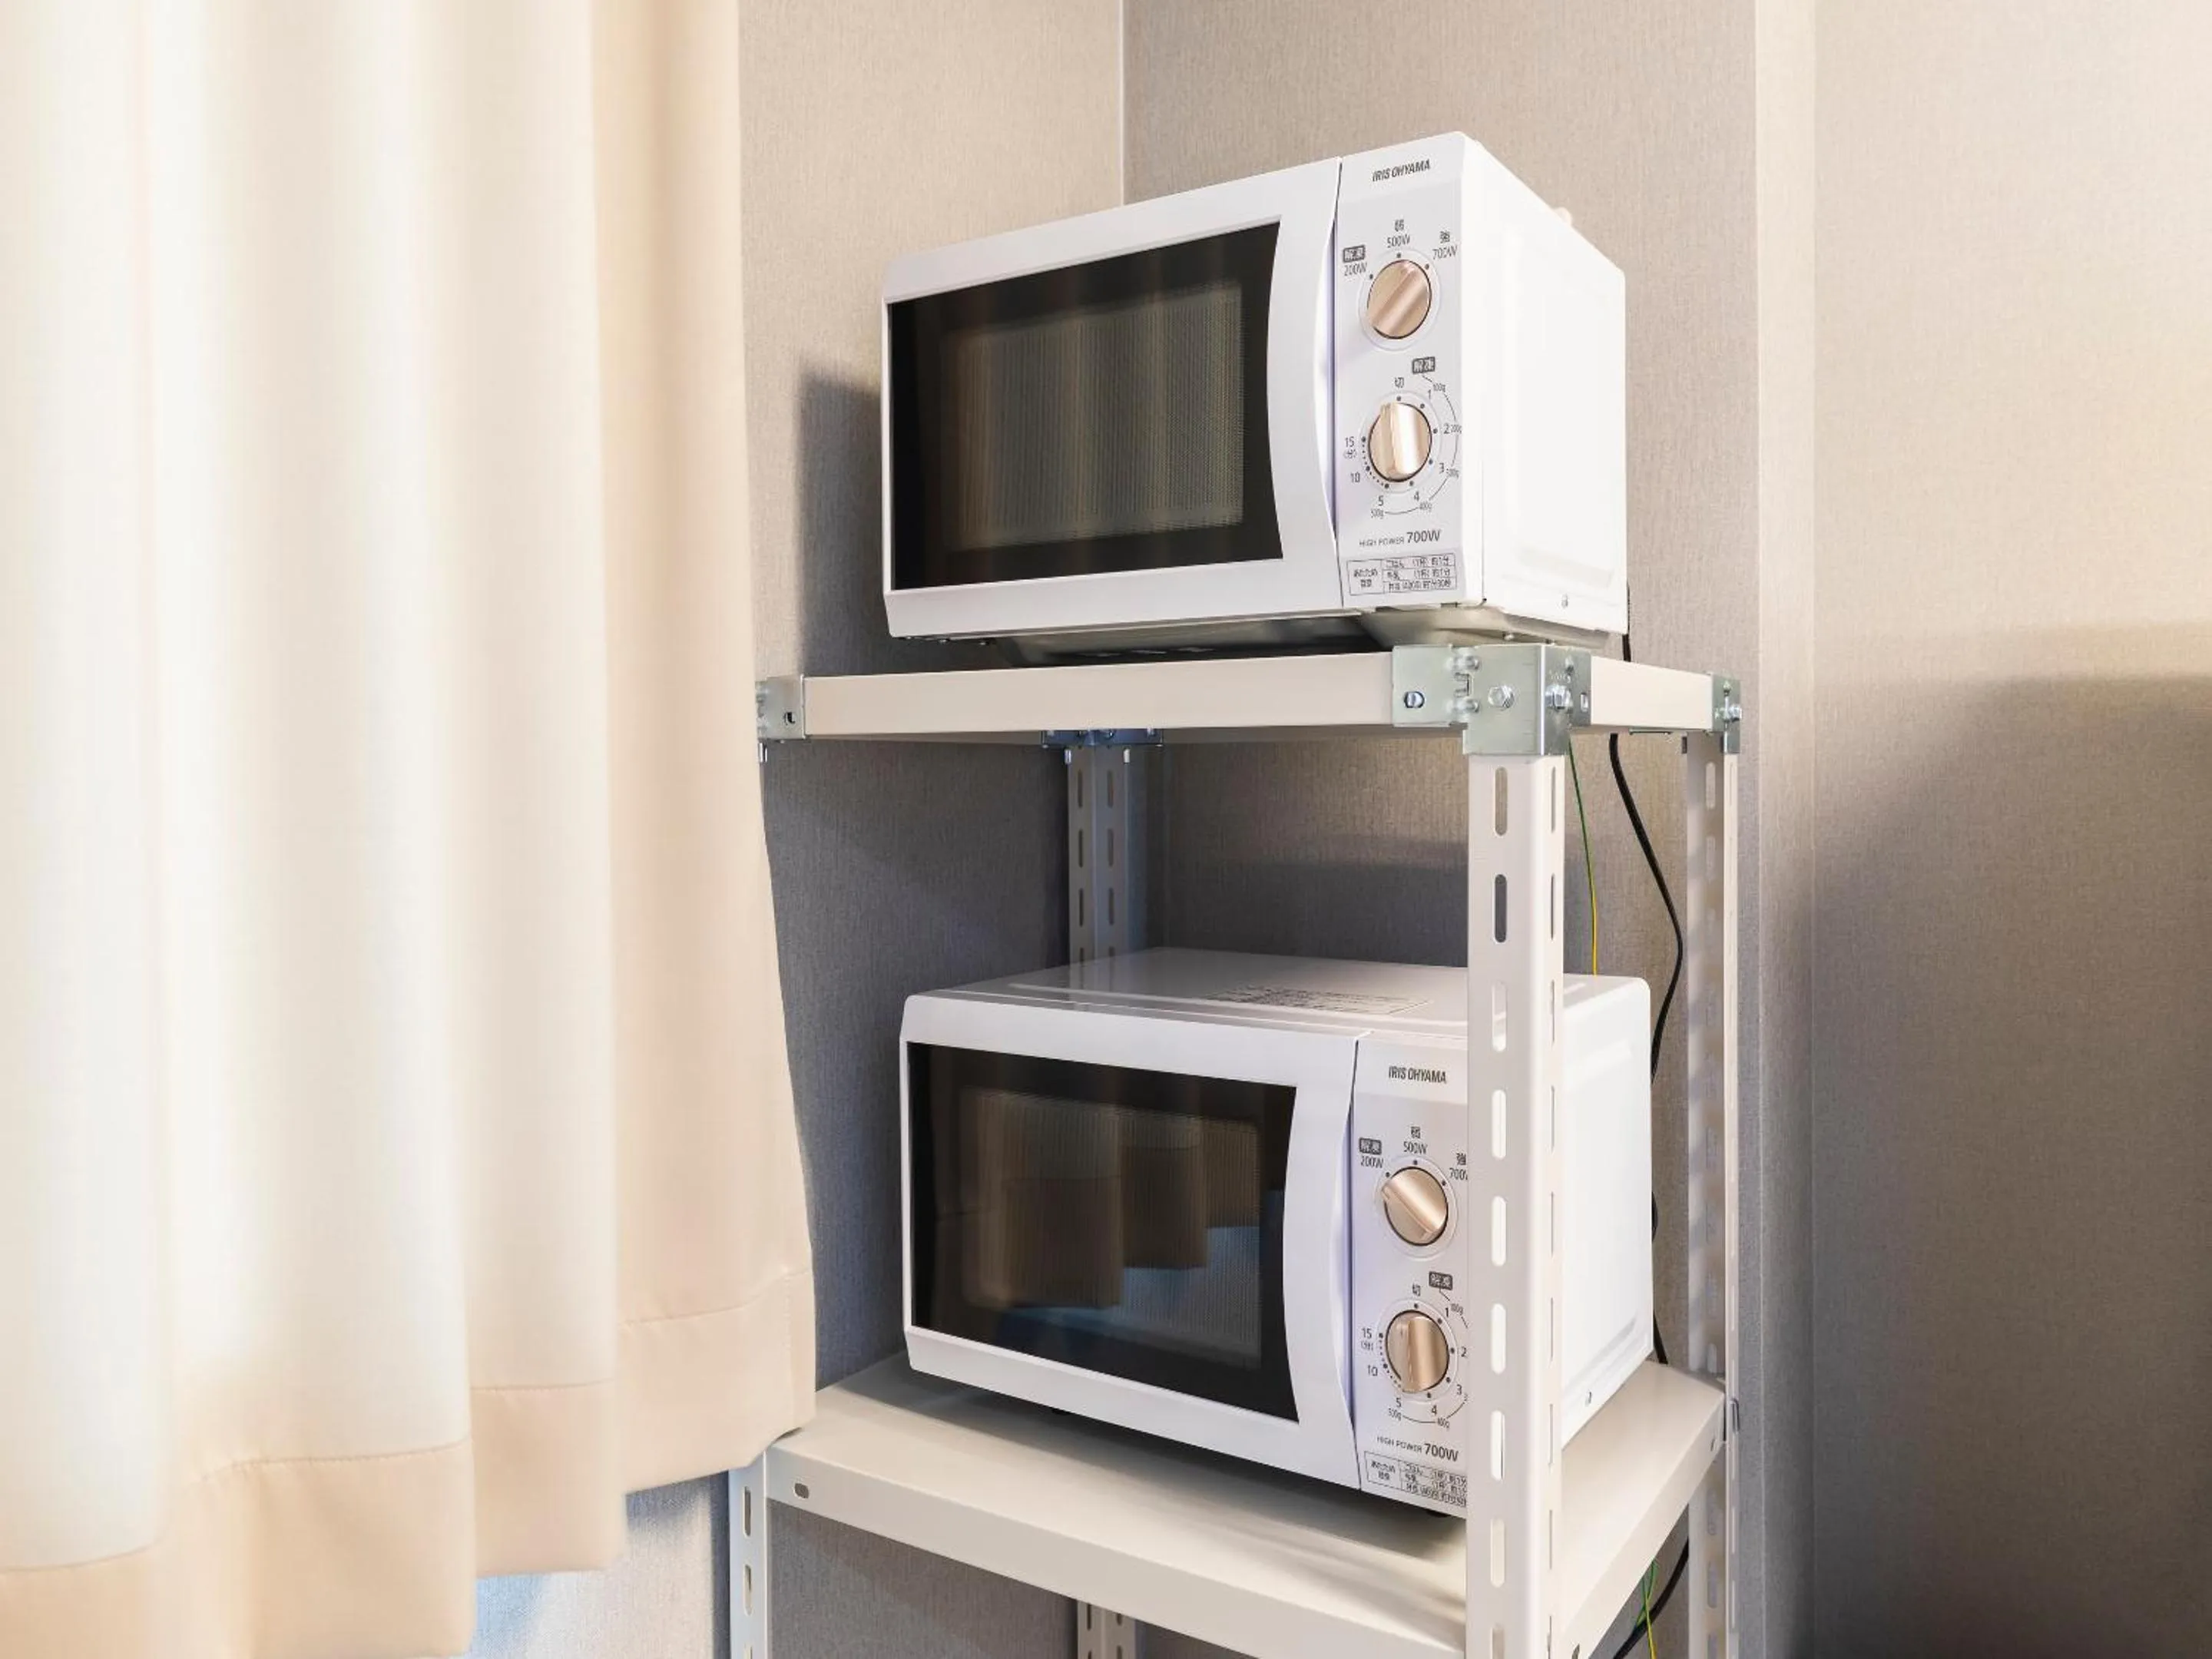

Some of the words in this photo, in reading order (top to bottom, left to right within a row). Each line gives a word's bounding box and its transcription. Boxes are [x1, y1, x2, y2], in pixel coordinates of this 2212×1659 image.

[1372, 167, 1390, 182] IRIS
[1392, 159, 1432, 178] OHYAMA
[1387, 234, 1410, 248] 500W
[1432, 246, 1458, 260] 700W
[1344, 262, 1367, 276] 200W
[1443, 422, 1449, 434] 2
[1345, 436, 1355, 448] 15
[1439, 462, 1444, 474] 3
[1350, 472, 1360, 483] 10
[1378, 495, 1384, 506] 5
[1413, 491, 1419, 502] 4
[1378, 536, 1405, 546] POWER
[1406, 528, 1441, 543] 700W
[1389, 1066, 1406, 1080] IRIS
[1408, 1068, 1447, 1084] OHYAMA
[1403, 1141, 1428, 1154] 500W
[1361, 1156, 1383, 1168] 200W
[1449, 1167, 1468, 1181] 700
[1362, 1328, 1372, 1339] 15
[1461, 1346, 1467, 1357] 2
[1368, 1365, 1378, 1376] 10
[1456, 1384, 1462, 1396] 3
[1396, 1397, 1402, 1408] 5
[1431, 1405, 1437, 1416] 4
[1377, 1436, 1394, 1446] HIGH
[1396, 1440, 1422, 1453] POWER
[1424, 1443, 1459, 1462] 700W
